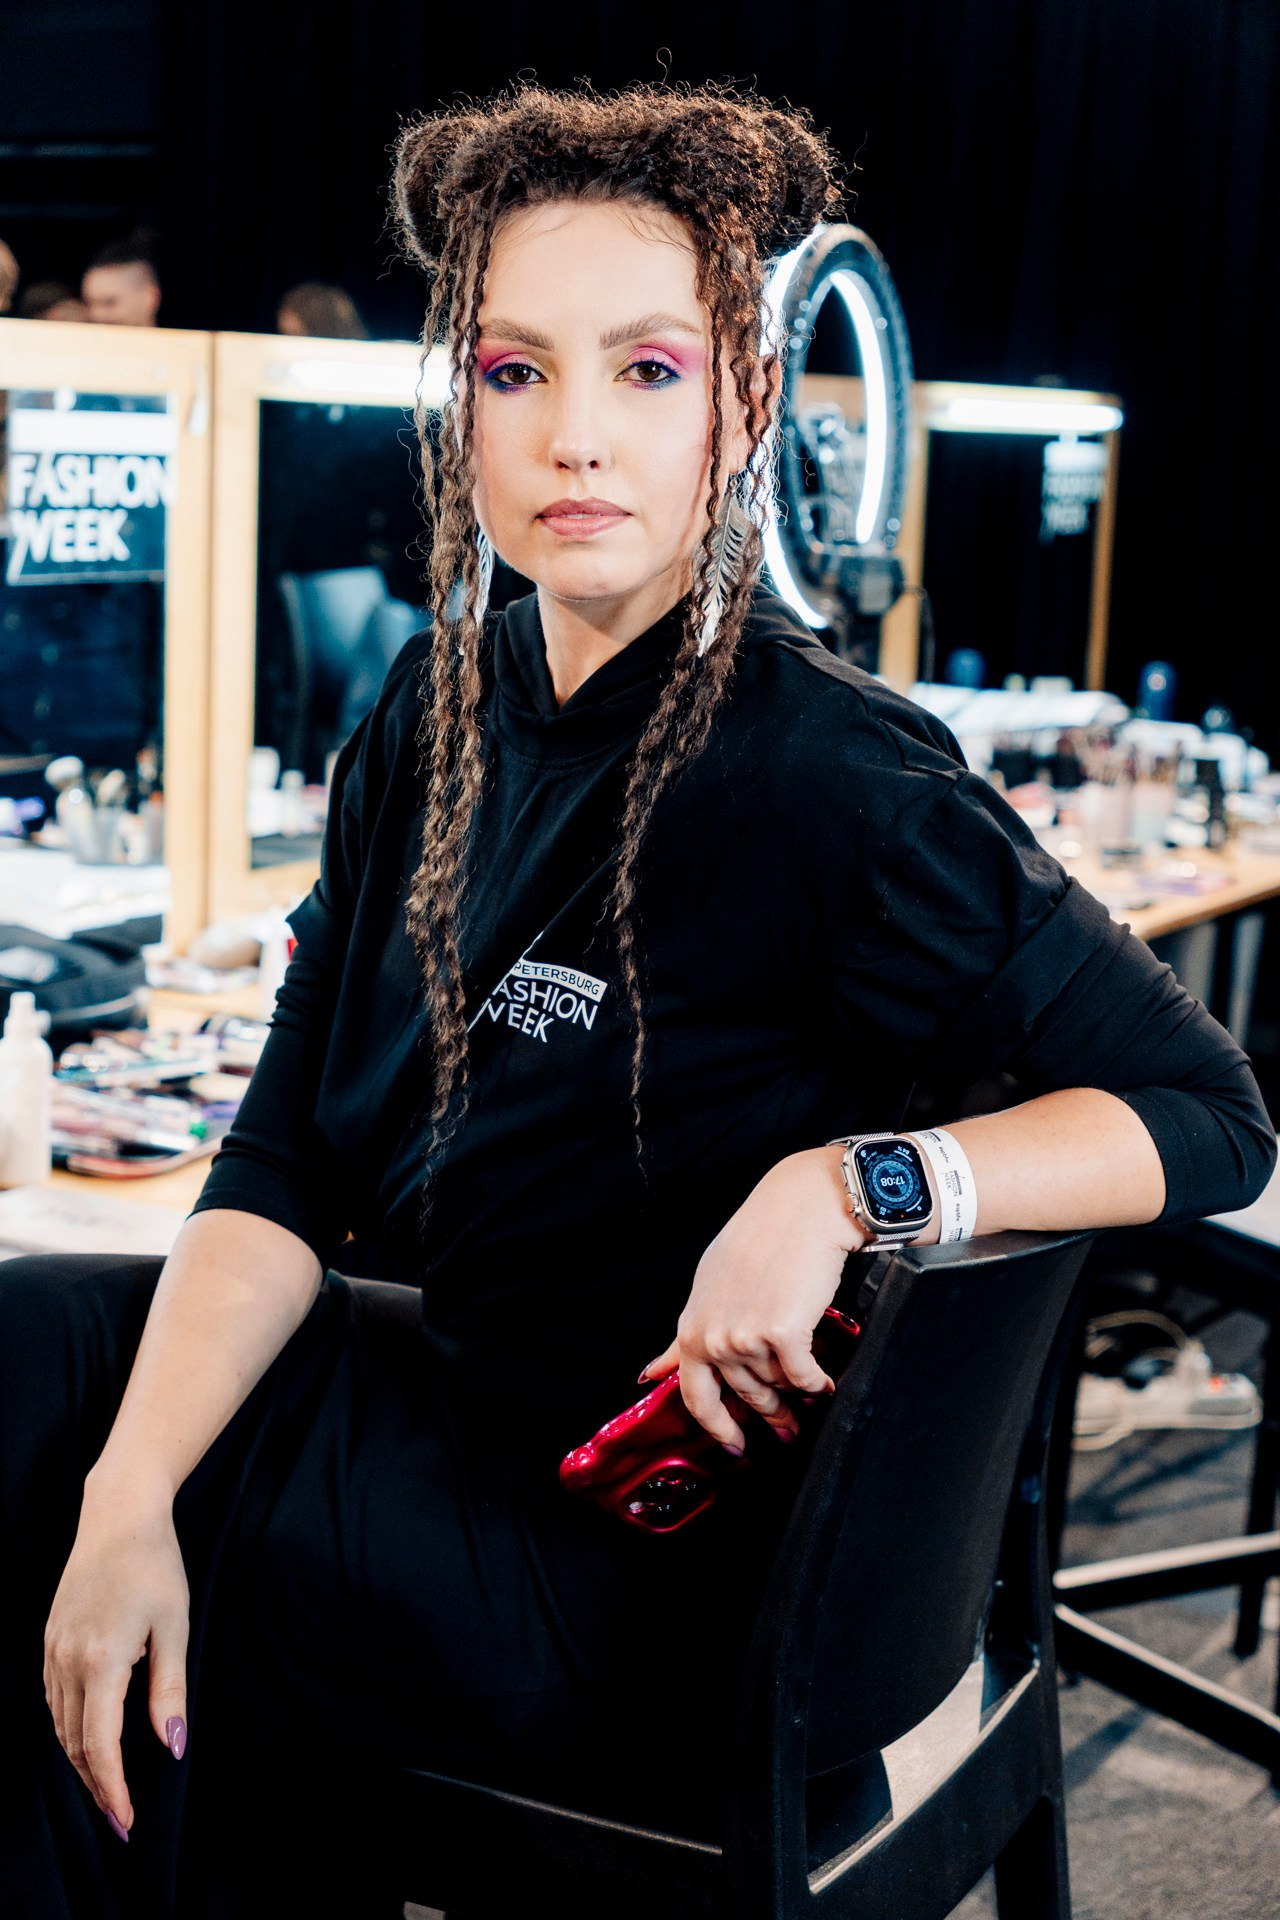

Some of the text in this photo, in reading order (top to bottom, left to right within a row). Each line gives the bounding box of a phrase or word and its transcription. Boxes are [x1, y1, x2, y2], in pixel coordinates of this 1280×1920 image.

[10, 453, 178, 508] FASHION
[7, 509, 131, 585] WEEK
[492, 980, 599, 1031] ASHION
[880, 1175, 906, 1187] 17:08
